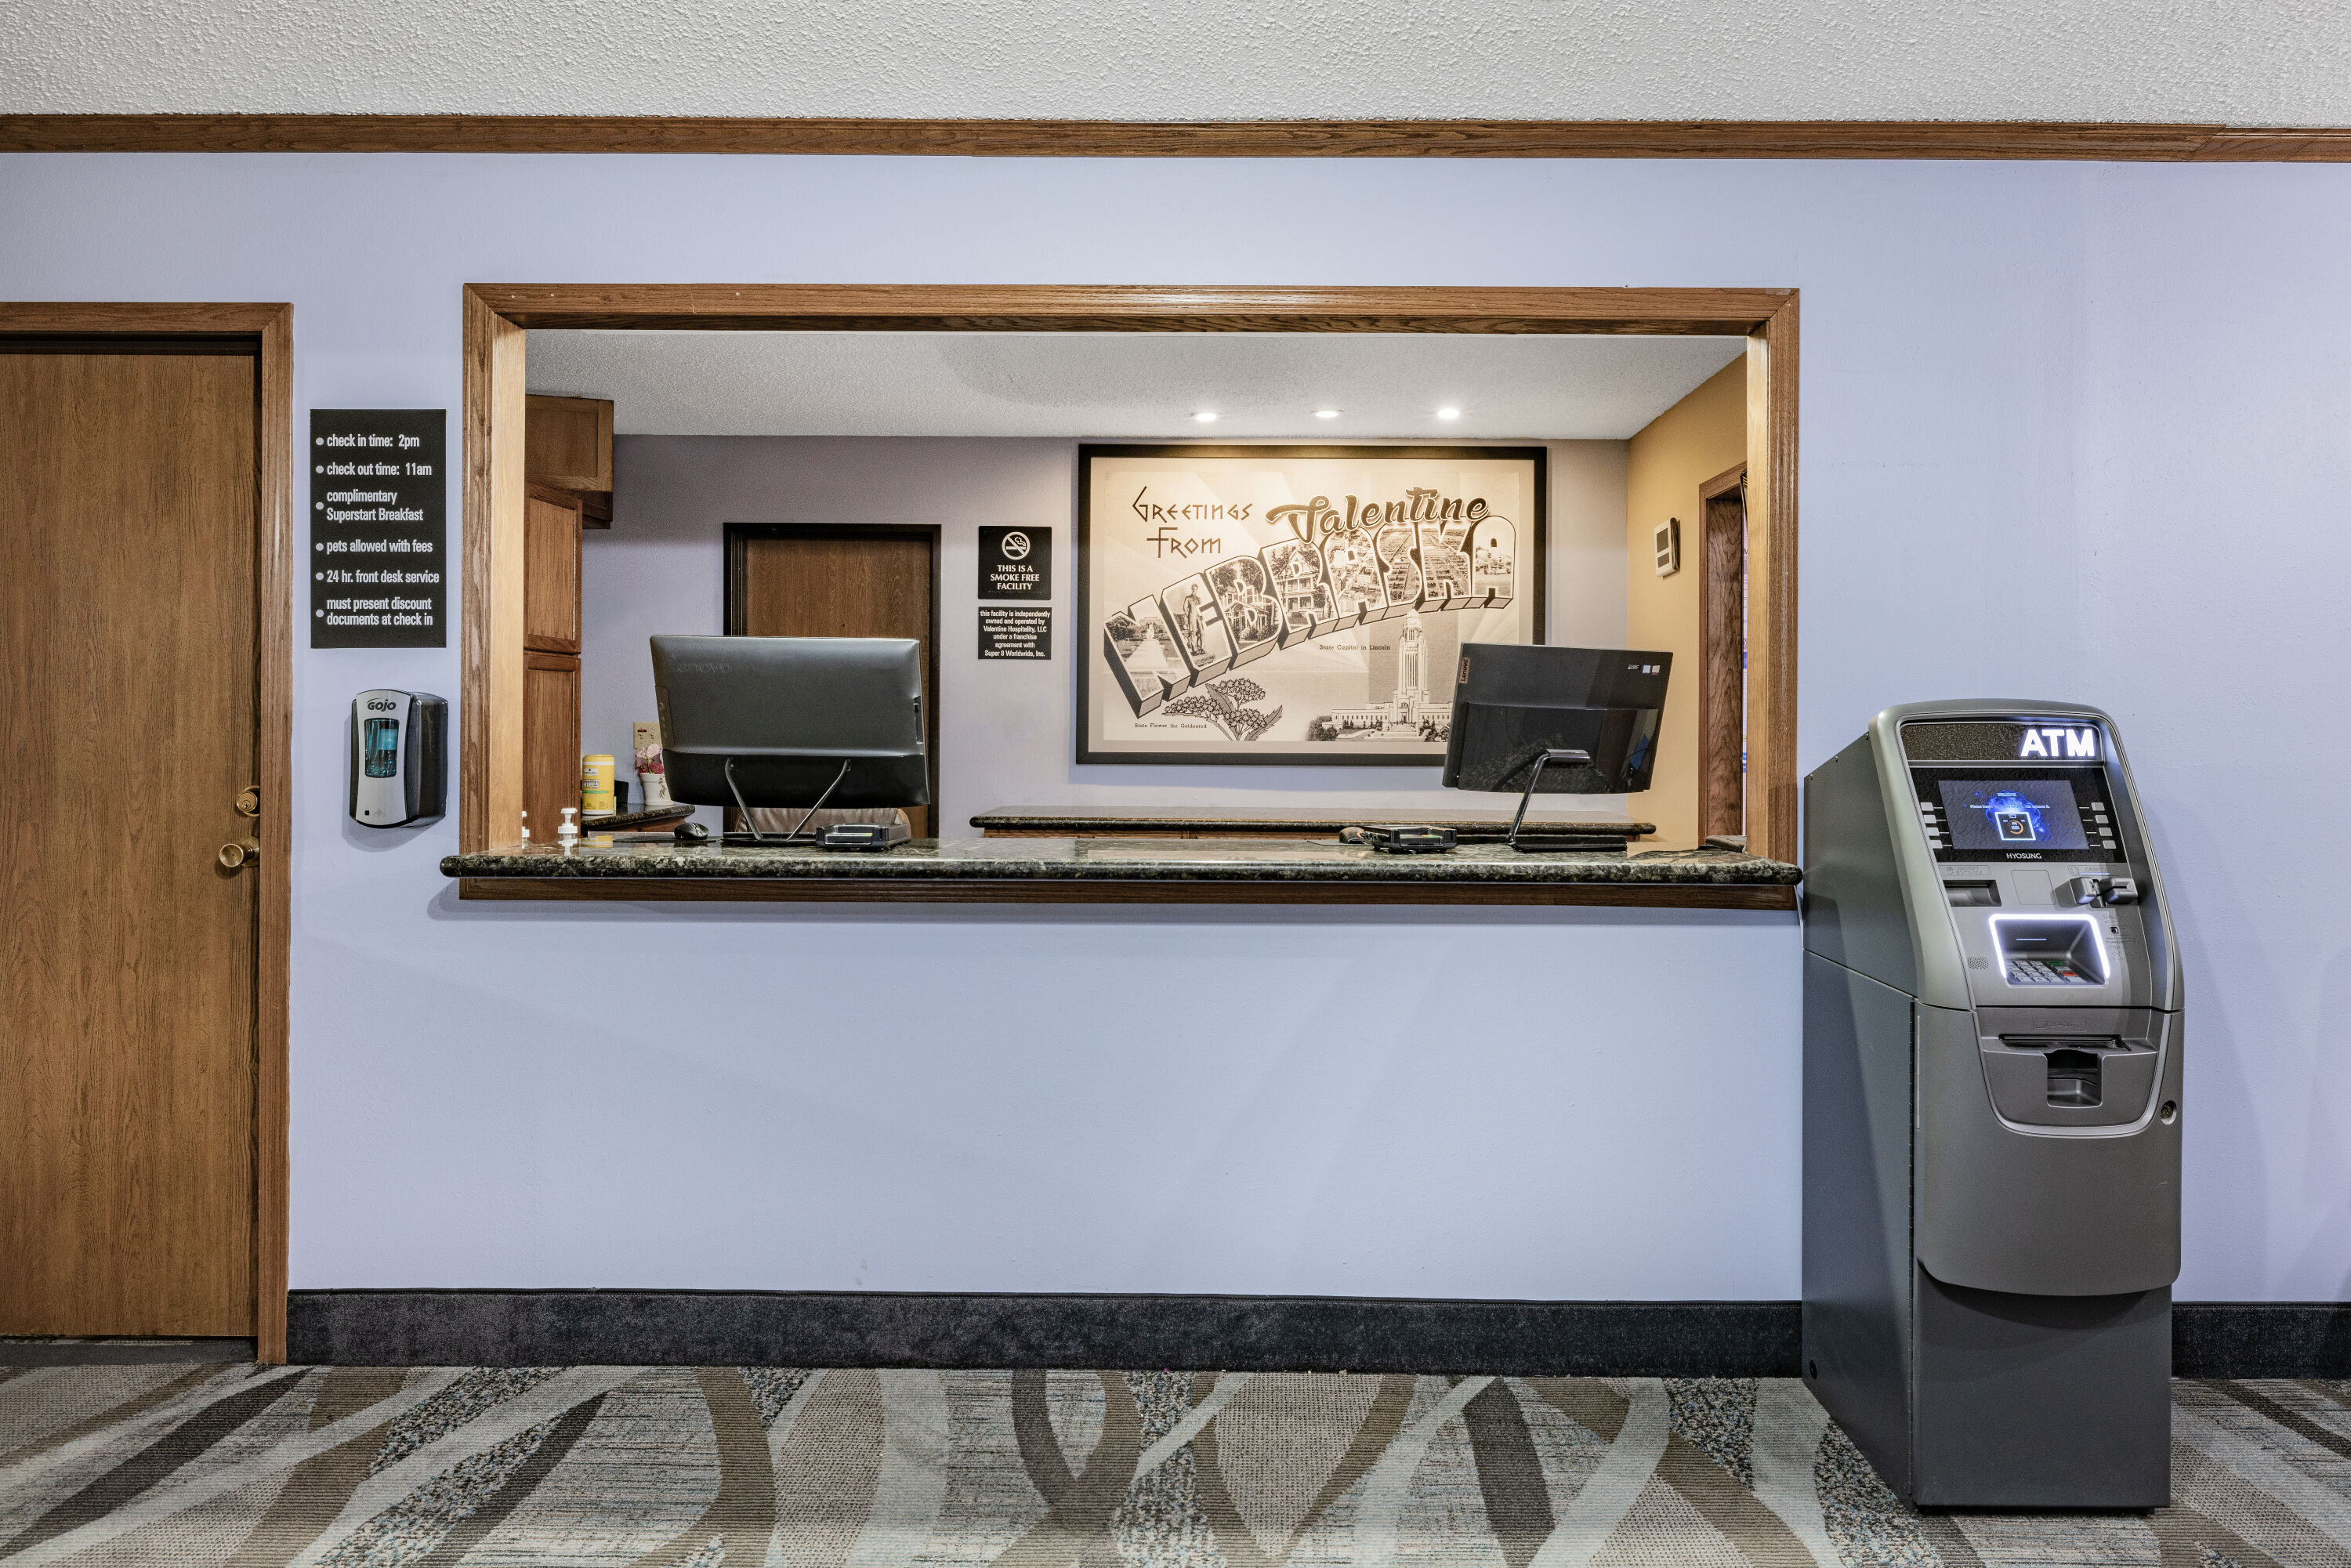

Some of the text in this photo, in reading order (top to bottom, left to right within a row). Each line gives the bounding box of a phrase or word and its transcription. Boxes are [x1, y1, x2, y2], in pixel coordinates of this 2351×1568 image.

[326, 433, 420, 450] check in time: 2pm
[326, 462, 433, 476] check out time: 11am
[326, 488, 398, 505] complimentary
[1132, 485, 1253, 523] GREETINGS
[326, 507, 424, 523] Superstart Breakfast
[1265, 486, 1490, 544] Valentine
[326, 538, 433, 556] pets allowed with fees
[1147, 527, 1221, 559] FROM
[997, 564, 1034, 573] THIS IS A
[326, 569, 440, 584] 24 hr. front desk service
[990, 573, 1040, 582] SMOKE FREE
[997, 582, 1033, 591] FACILITY
[326, 596, 433, 613] must present discount
[326, 611, 433, 626] documents at check in
[991, 610, 1009, 618] facility
[1015, 610, 1051, 618] independently
[1015, 617, 1038, 626] operated
[1038, 617, 1045, 626] by
[1103, 515, 1516, 719] NEBRASKA
[1008, 625, 1036, 634] Hospitality,
[995, 641, 1023, 650] agreement
[984, 650, 1001, 658] Super
[1005, 650, 1034, 658] Worldwide,
[2020, 729, 2096, 757] ATM
